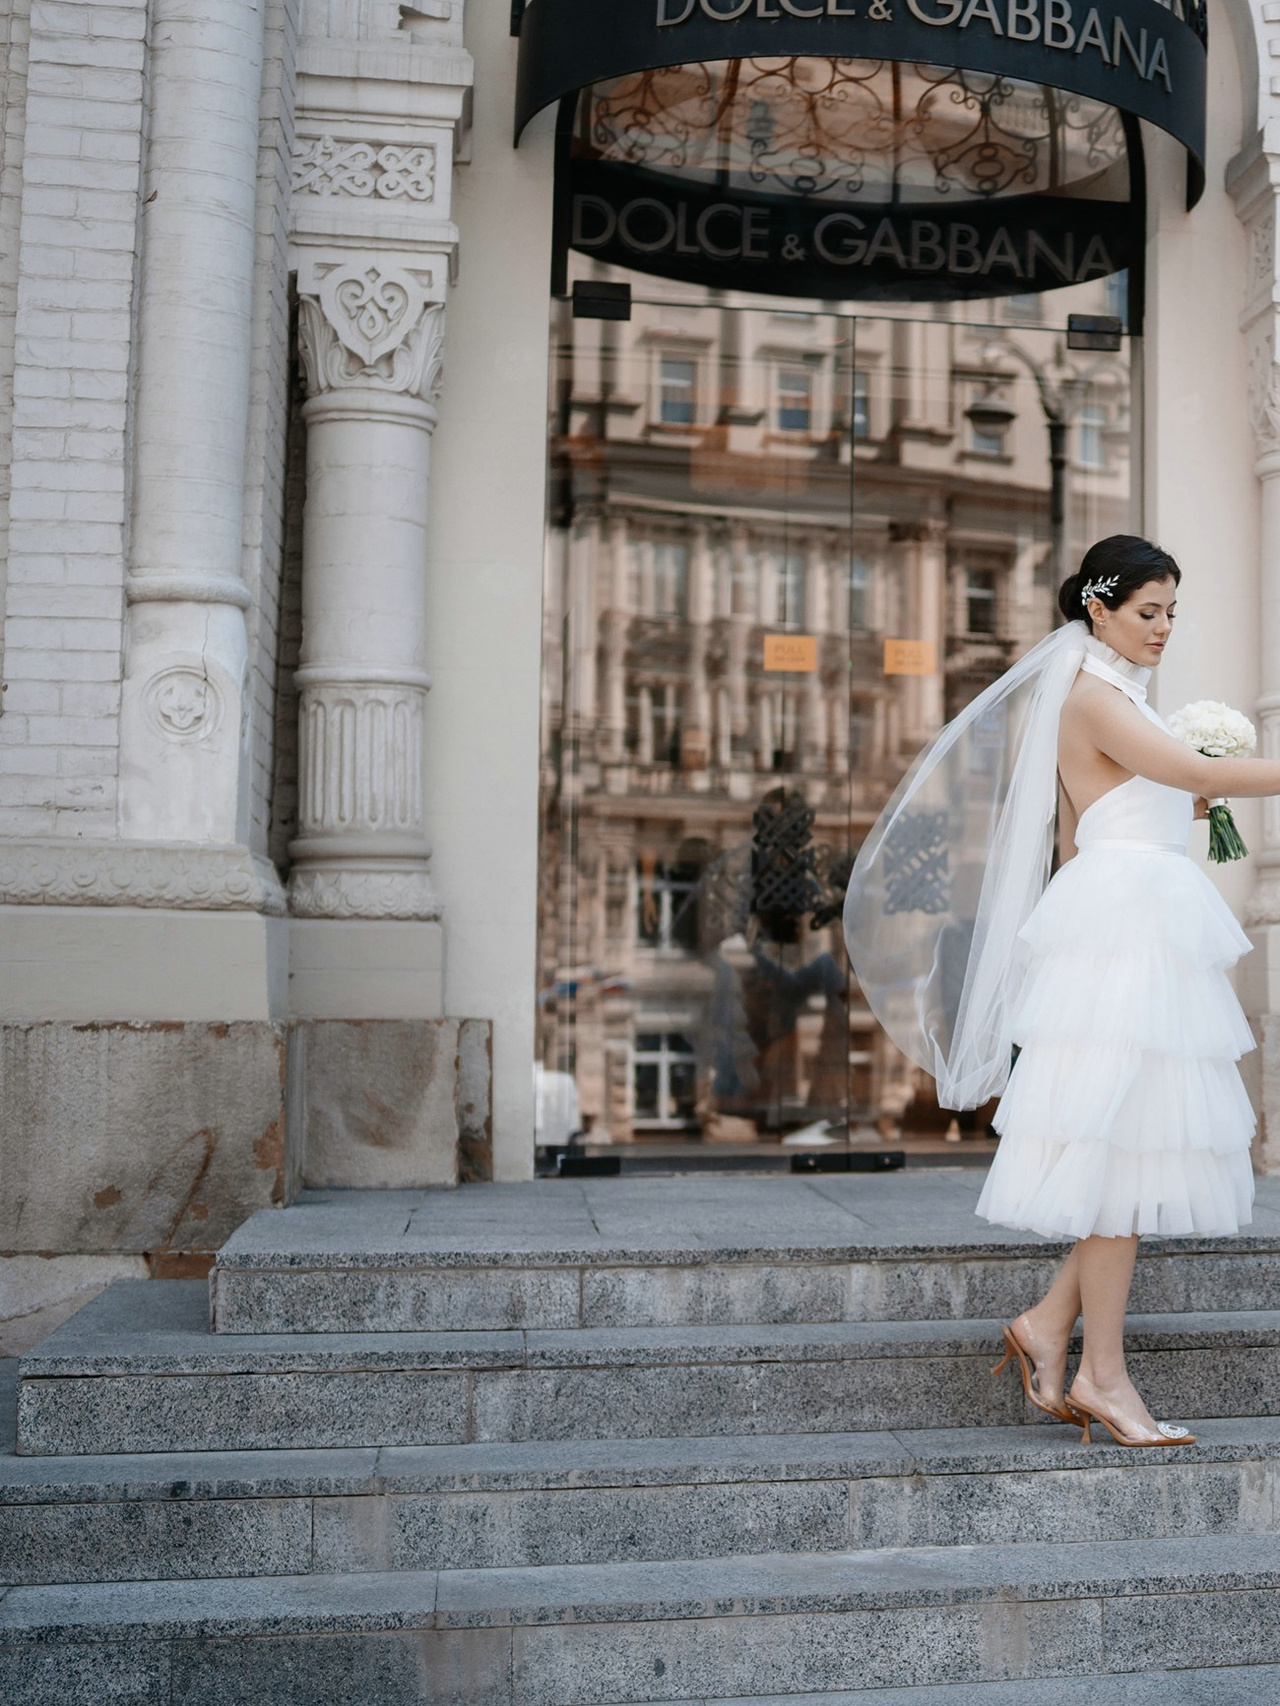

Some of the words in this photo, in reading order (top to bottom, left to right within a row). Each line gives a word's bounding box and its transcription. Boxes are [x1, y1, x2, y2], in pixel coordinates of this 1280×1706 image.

[907, 0, 1172, 93] GABBANA
[571, 193, 772, 261] DOLCE
[781, 233, 808, 263] &
[813, 212, 1116, 281] GABBANA
